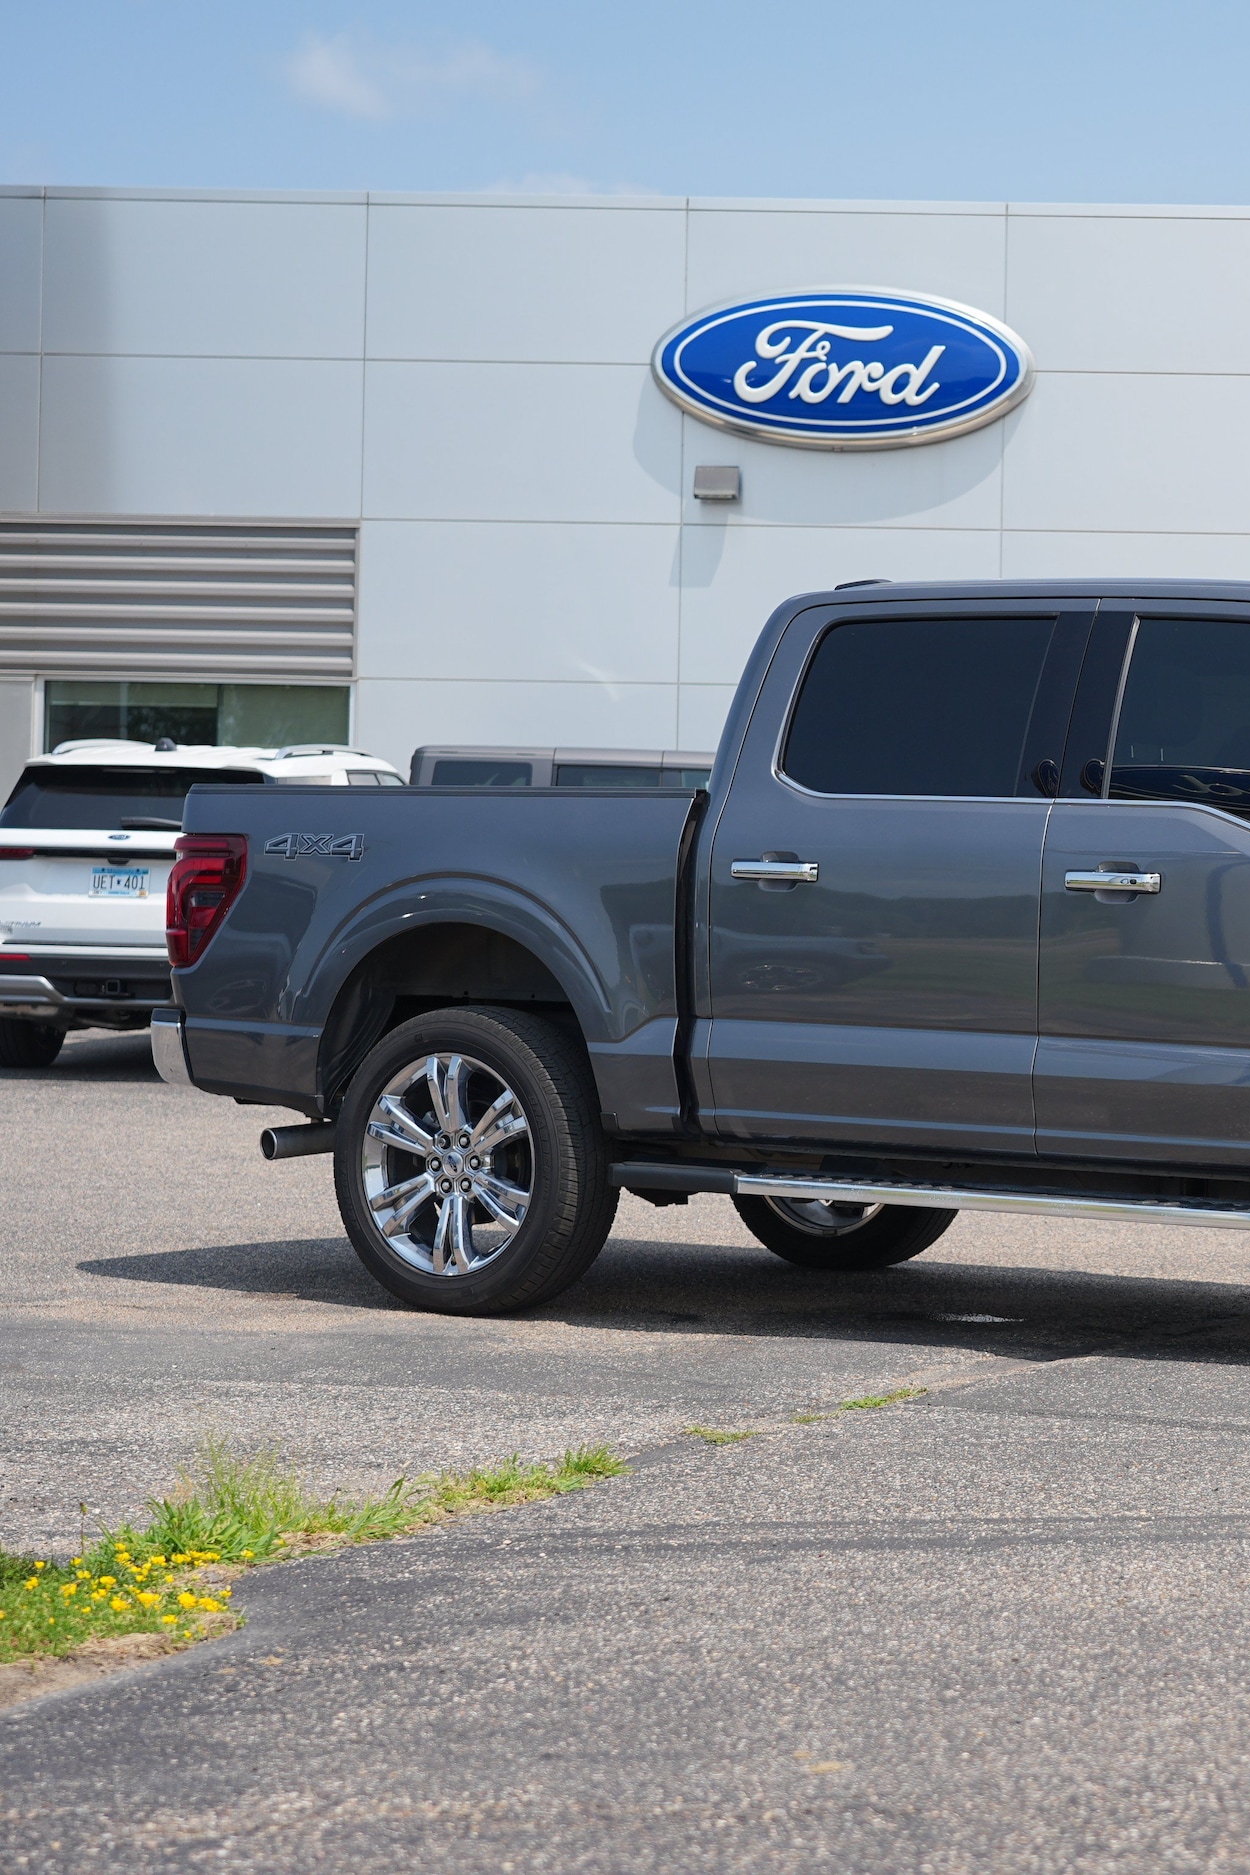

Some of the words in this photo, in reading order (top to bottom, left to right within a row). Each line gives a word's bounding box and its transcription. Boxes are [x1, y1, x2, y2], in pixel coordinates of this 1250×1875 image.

[733, 319, 946, 407] Ford
[93, 874, 115, 890] UET
[124, 874, 145, 890] 401
